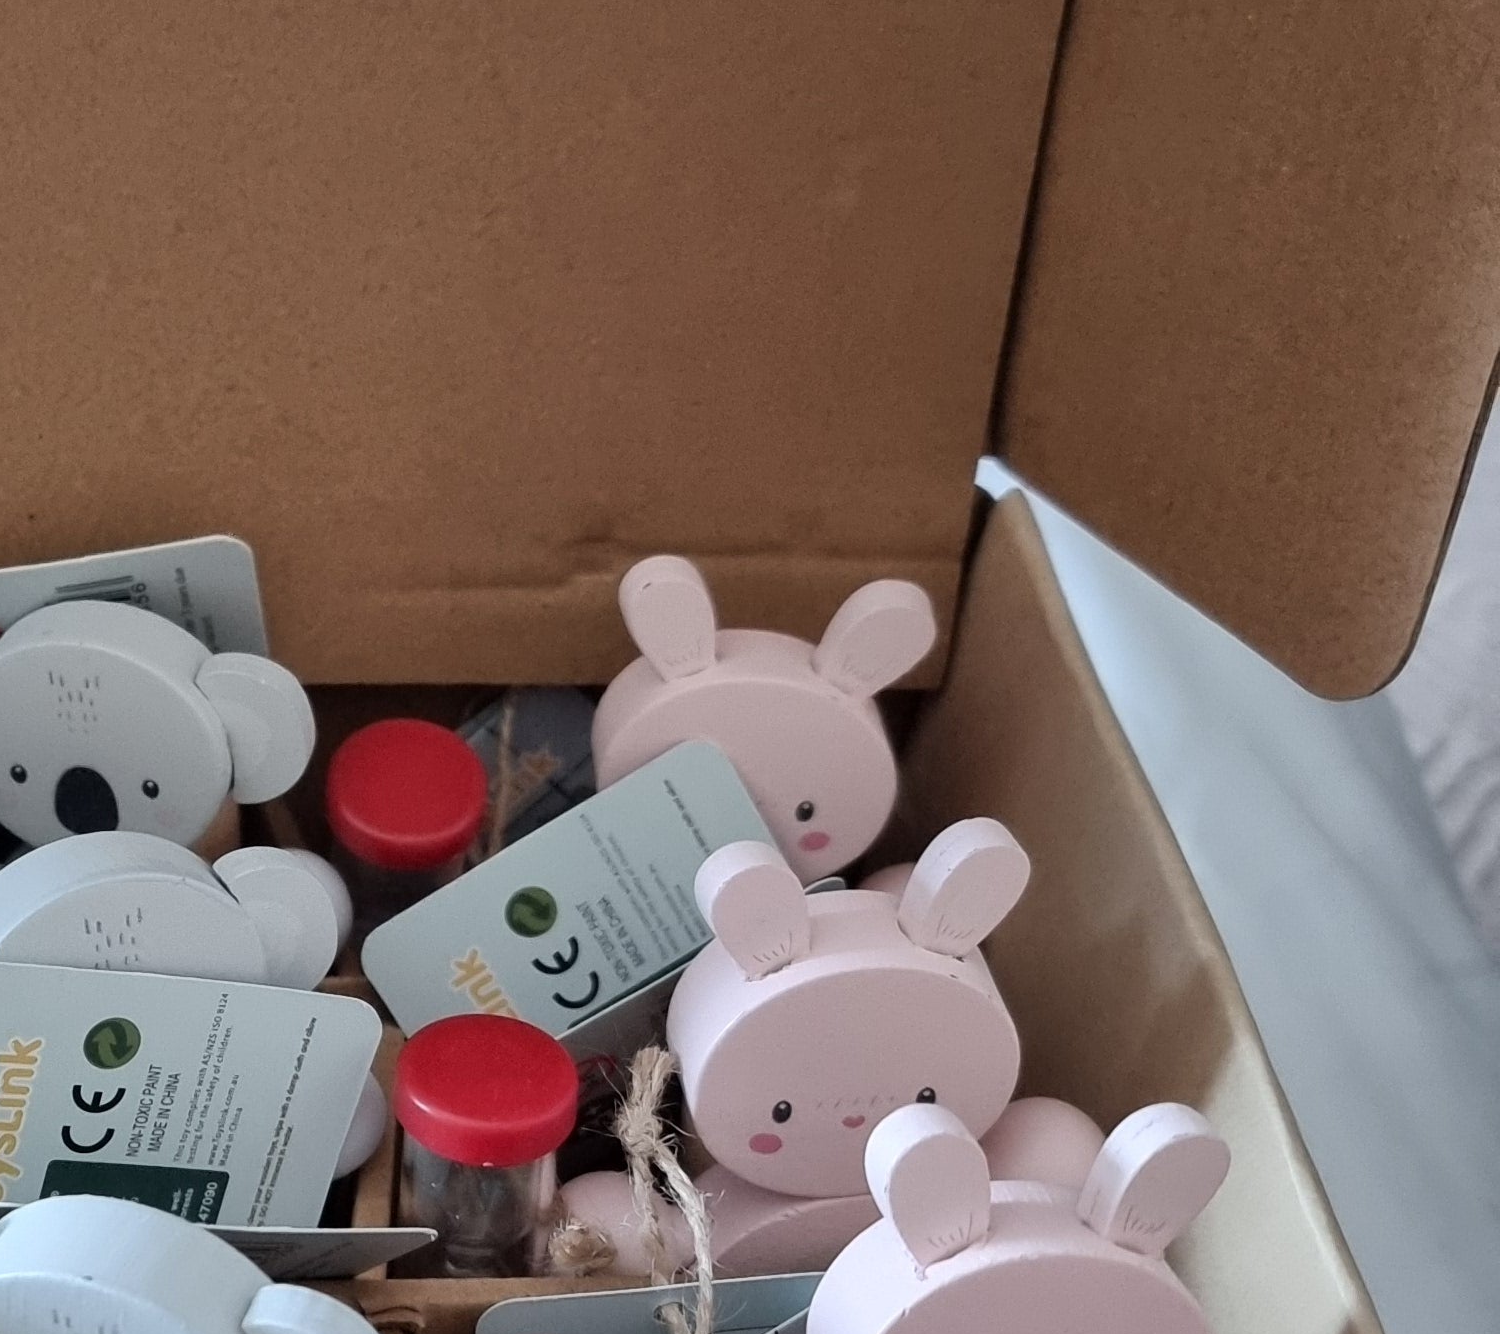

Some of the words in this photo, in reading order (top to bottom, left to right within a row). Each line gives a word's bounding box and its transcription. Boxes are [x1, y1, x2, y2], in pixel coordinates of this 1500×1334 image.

[159, 1071, 180, 1106] CHINA
[125, 1096, 153, 1157] NON-TOXIC
[141, 1063, 162, 1096] PAINT
[155, 1107, 170, 1119] IN
[146, 1120, 167, 1152] MADE
[197, 1180, 218, 1221] 47090
